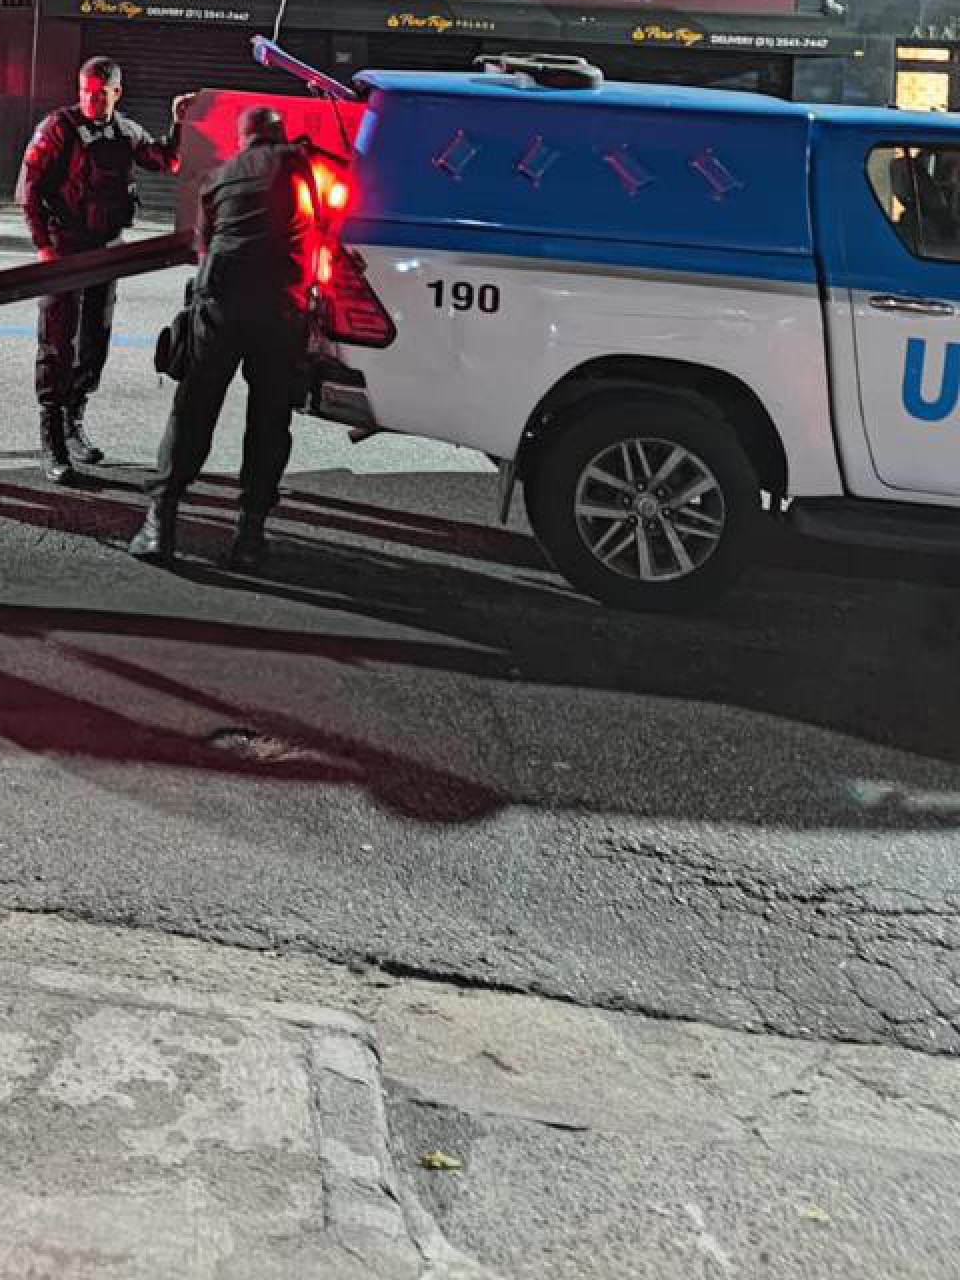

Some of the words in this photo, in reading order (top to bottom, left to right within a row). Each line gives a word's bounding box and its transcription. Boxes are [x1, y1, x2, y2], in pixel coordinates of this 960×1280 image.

[710, 34, 753, 46] DELIVERY
[426, 279, 500, 314] 190
[902, 337, 960, 422] U
